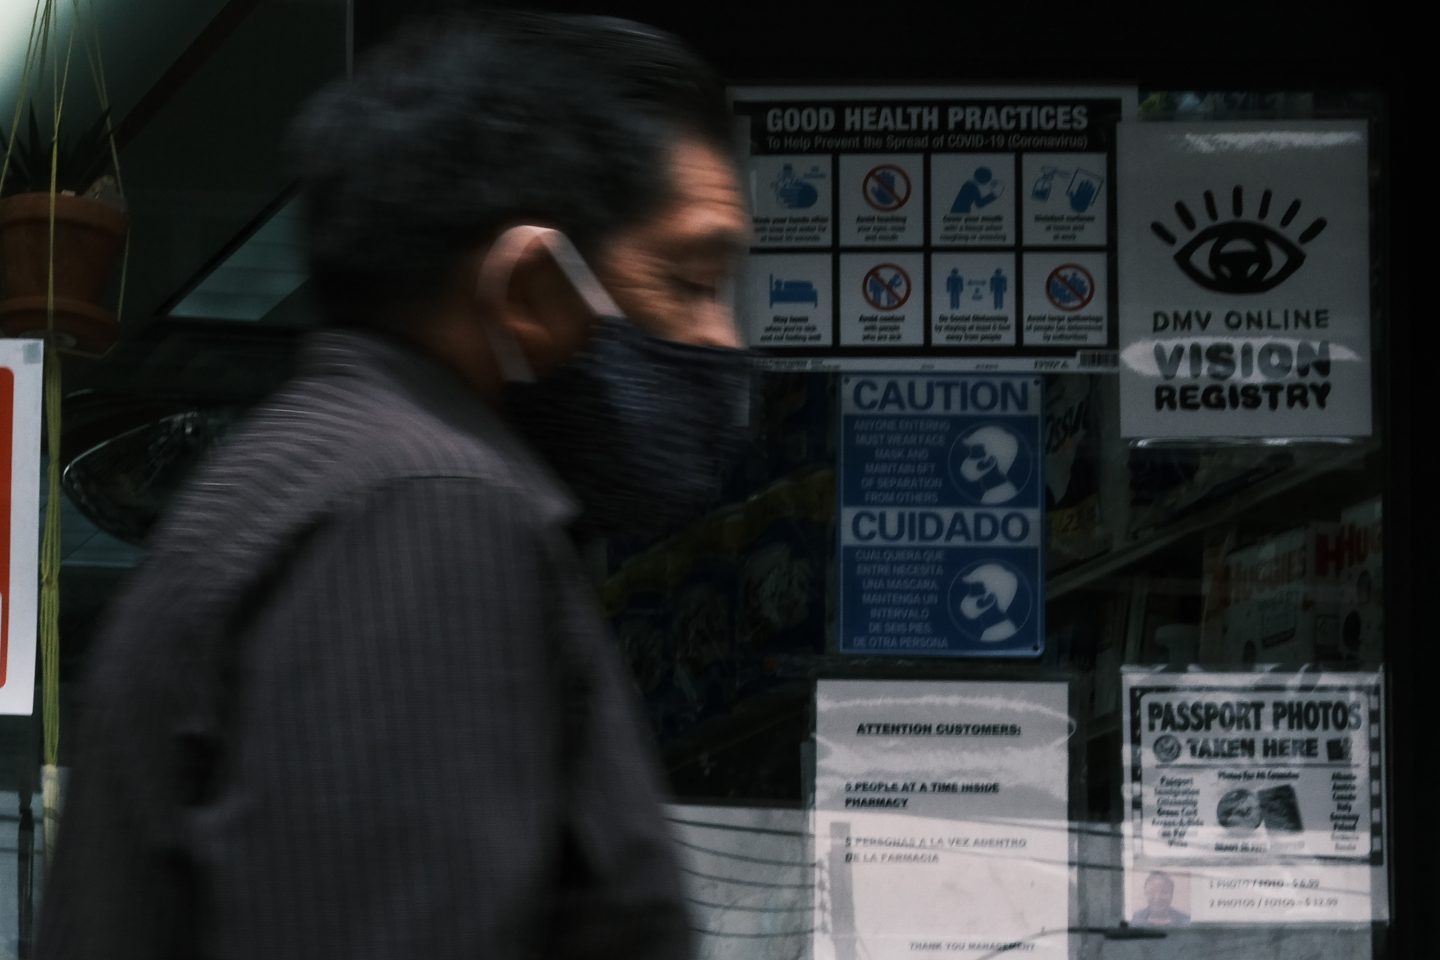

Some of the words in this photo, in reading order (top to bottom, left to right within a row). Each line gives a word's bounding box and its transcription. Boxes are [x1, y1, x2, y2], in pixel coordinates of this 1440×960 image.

[766, 106, 839, 132] GOOD
[844, 106, 940, 131] HEALTH
[947, 105, 1089, 130] PRACTICES
[767, 134, 781, 152] To
[783, 134, 812, 152] Help
[814, 134, 860, 152] Prevent
[863, 134, 883, 152] the
[886, 134, 929, 152] Spread
[932, 134, 944, 152] of
[947, 134, 1004, 152] COVID-19
[1007, 134, 1088, 152] (Coronavirus)
[1152, 310, 1212, 333] DMV
[1224, 309, 1330, 330] ONLINE
[1153, 341, 1331, 381] VISION
[853, 380, 1028, 411] CAUTION
[1154, 382, 1332, 411] REGISTRY
[875, 448, 904, 459] MASK
[907, 448, 929, 459] AND
[864, 492, 894, 504] FROM
[897, 492, 938, 504] OTHERS
[851, 511, 1030, 543] CUIDADO
[1147, 701, 1264, 731] PASSPORT
[1272, 701, 1362, 731] PHOTOS
[856, 723, 932, 737] ATTENTION
[1186, 738, 1255, 759] TAKEN
[1263, 738, 1320, 758] HERE
[854, 782, 899, 793] PEOPLE
[901, 782, 916, 793] AT
[930, 782, 958, 793] TIME
[961, 782, 999, 793] INSIDE
[844, 798, 909, 809] PHARMACY
